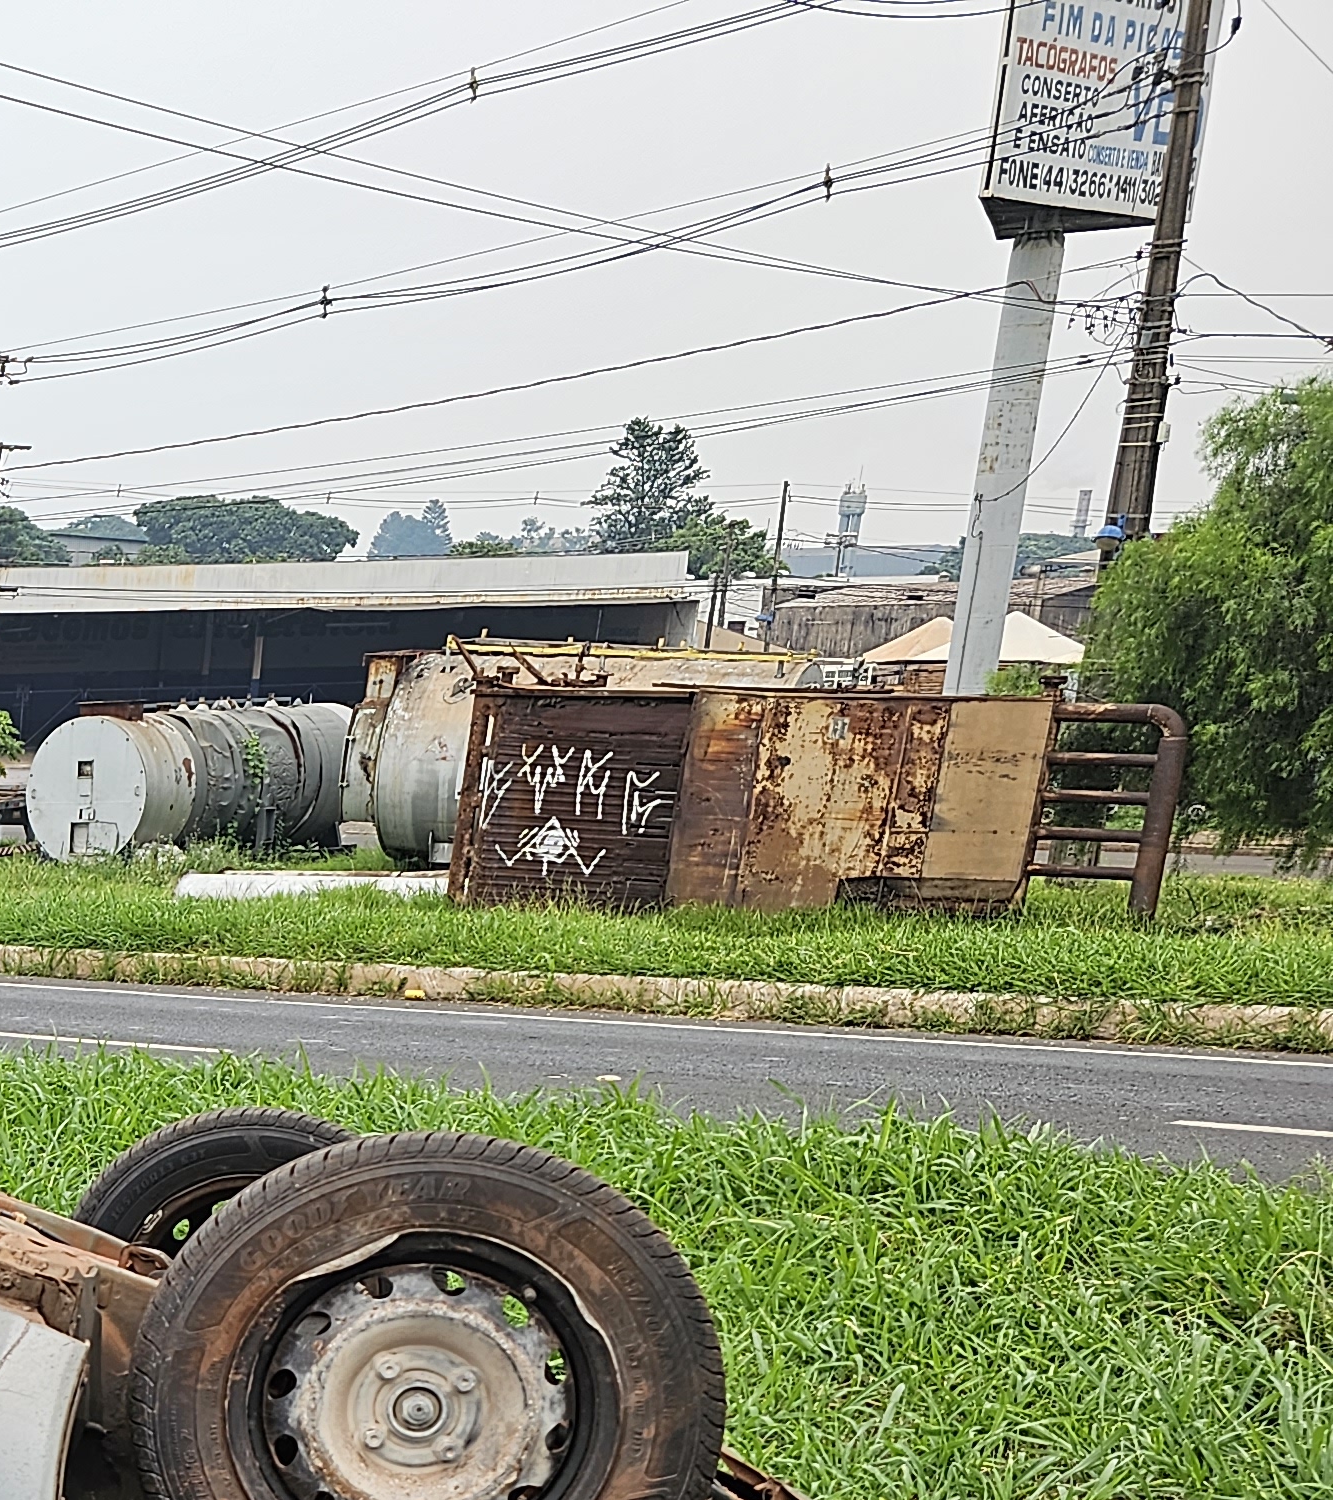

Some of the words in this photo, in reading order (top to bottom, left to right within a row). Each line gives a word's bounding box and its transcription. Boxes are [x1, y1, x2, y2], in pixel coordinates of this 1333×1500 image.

[1042, 1, 1084, 39] FIM
[1090, 11, 1116, 47] DA
[1123, 19, 1185, 60] PICAD
[1016, 36, 1118, 85] TACÓGRAFOS
[1021, 73, 1100, 108] CONSERTO
[1017, 101, 1094, 135] AFERIÇÃO
[1013, 129, 1023, 149] E
[1027, 131, 1087, 160] ENSAIO
[1087, 144, 1121, 167] CONSERTO
[239, 1173, 472, 1271] GOODYEAR
